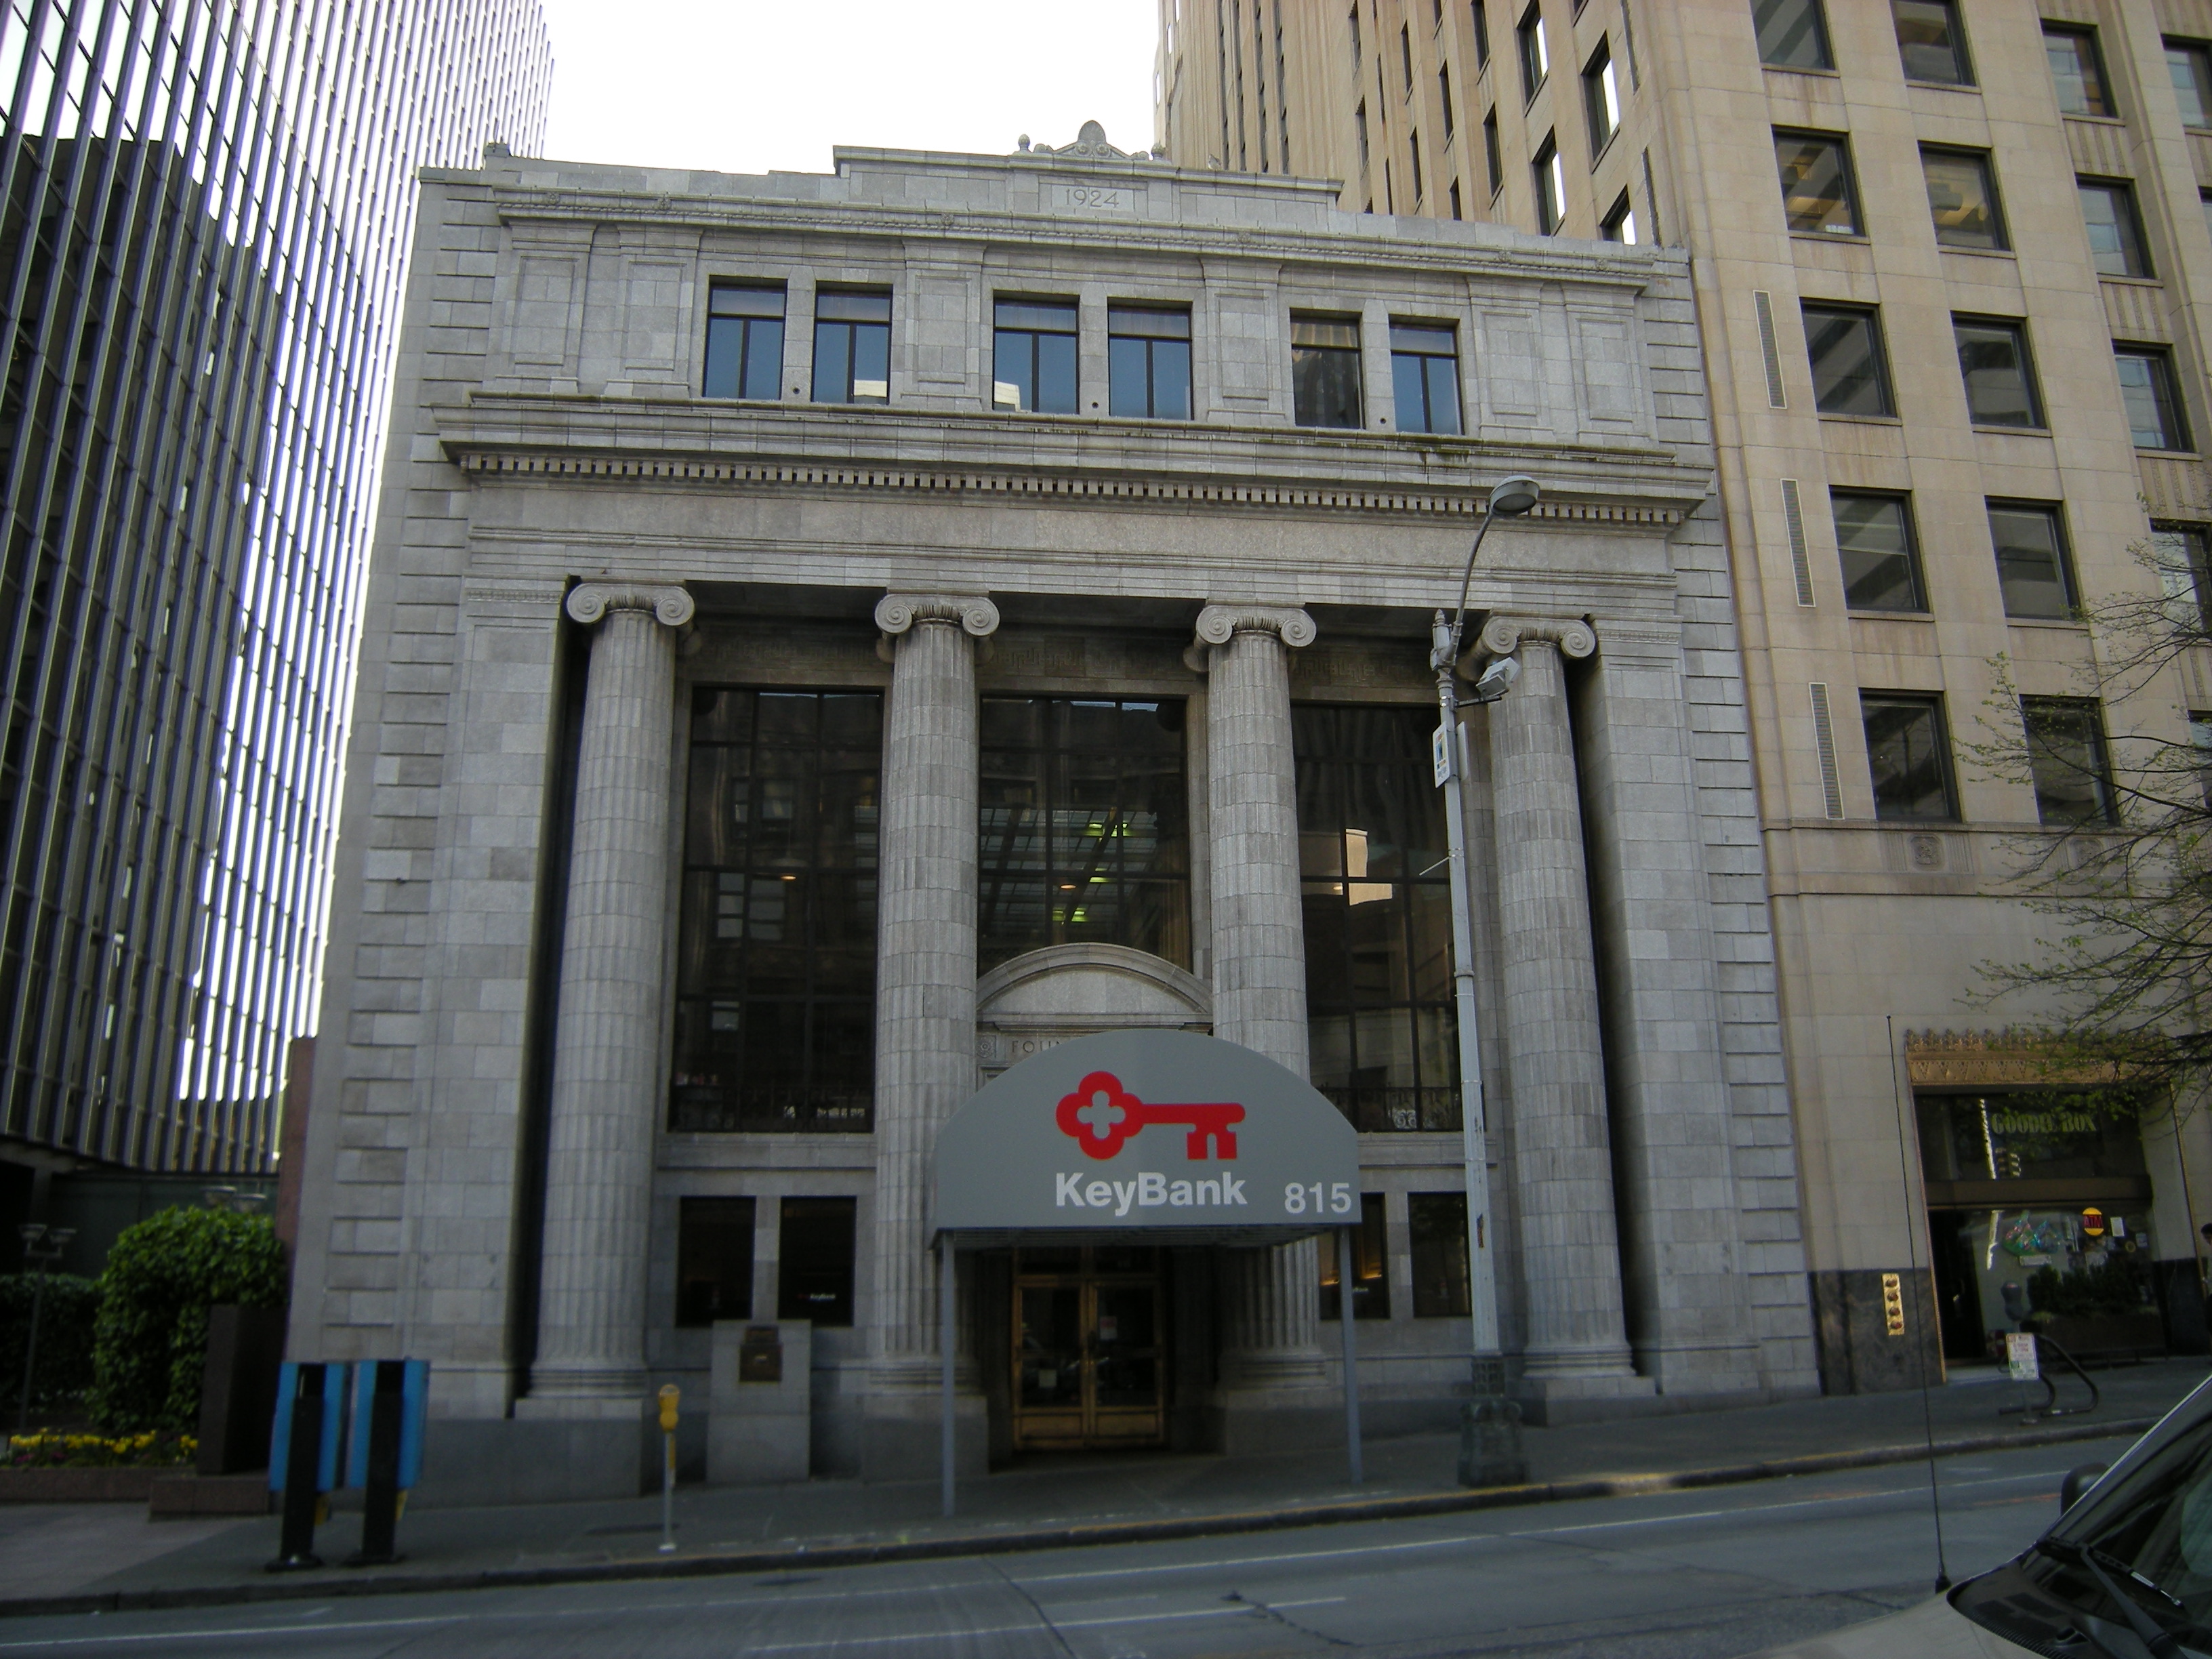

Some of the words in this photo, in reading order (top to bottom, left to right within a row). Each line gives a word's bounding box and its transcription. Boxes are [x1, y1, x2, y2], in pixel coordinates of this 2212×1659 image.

[1065, 188, 1120, 208] 1924
[2060, 1111, 2097, 1132] BOX
[1056, 1172, 1248, 1216] KeyBank
[1284, 1182, 1351, 1214] 815
[2084, 1215, 2103, 1228] ATM
